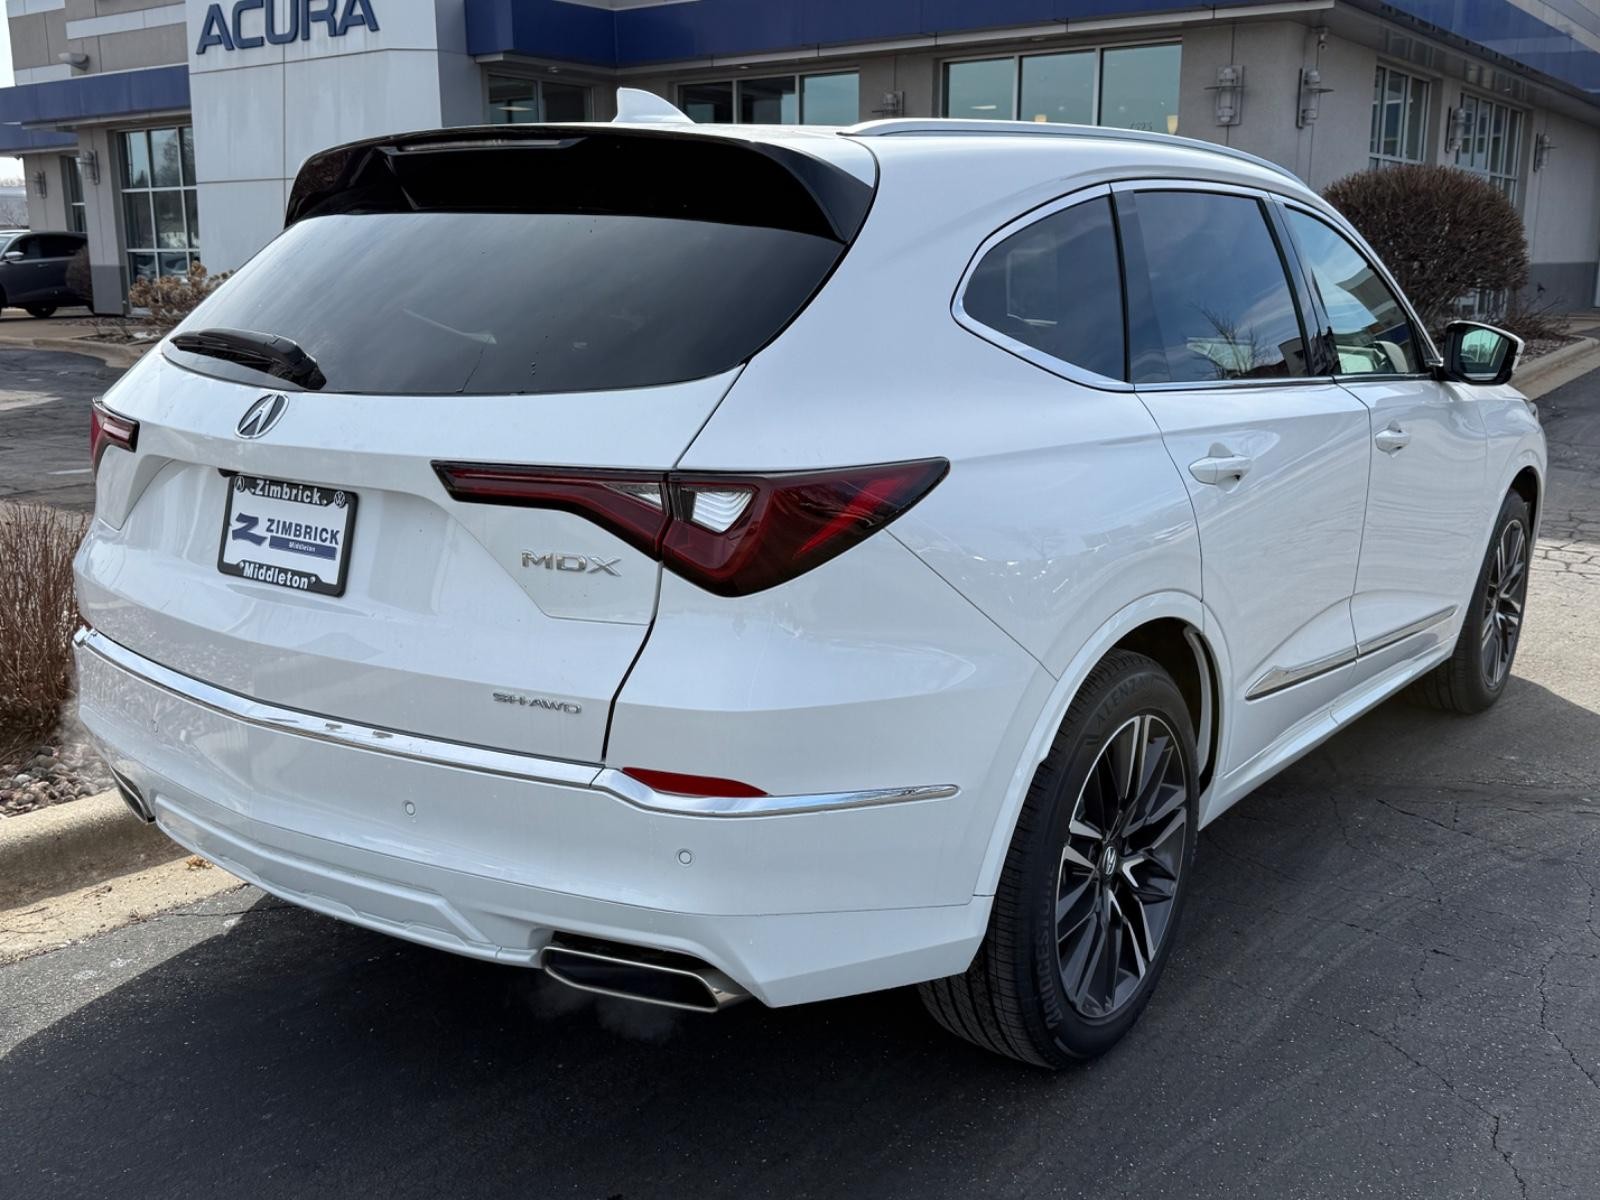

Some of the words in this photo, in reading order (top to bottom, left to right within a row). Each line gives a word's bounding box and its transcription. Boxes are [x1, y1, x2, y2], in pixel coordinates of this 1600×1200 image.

[196, 0, 380, 55] ACURA
[255, 479, 322, 504] Zimbrick
[266, 518, 341, 545] ZIMBRICK
[242, 562, 309, 589] Middleton
[521, 550, 622, 577] MDX
